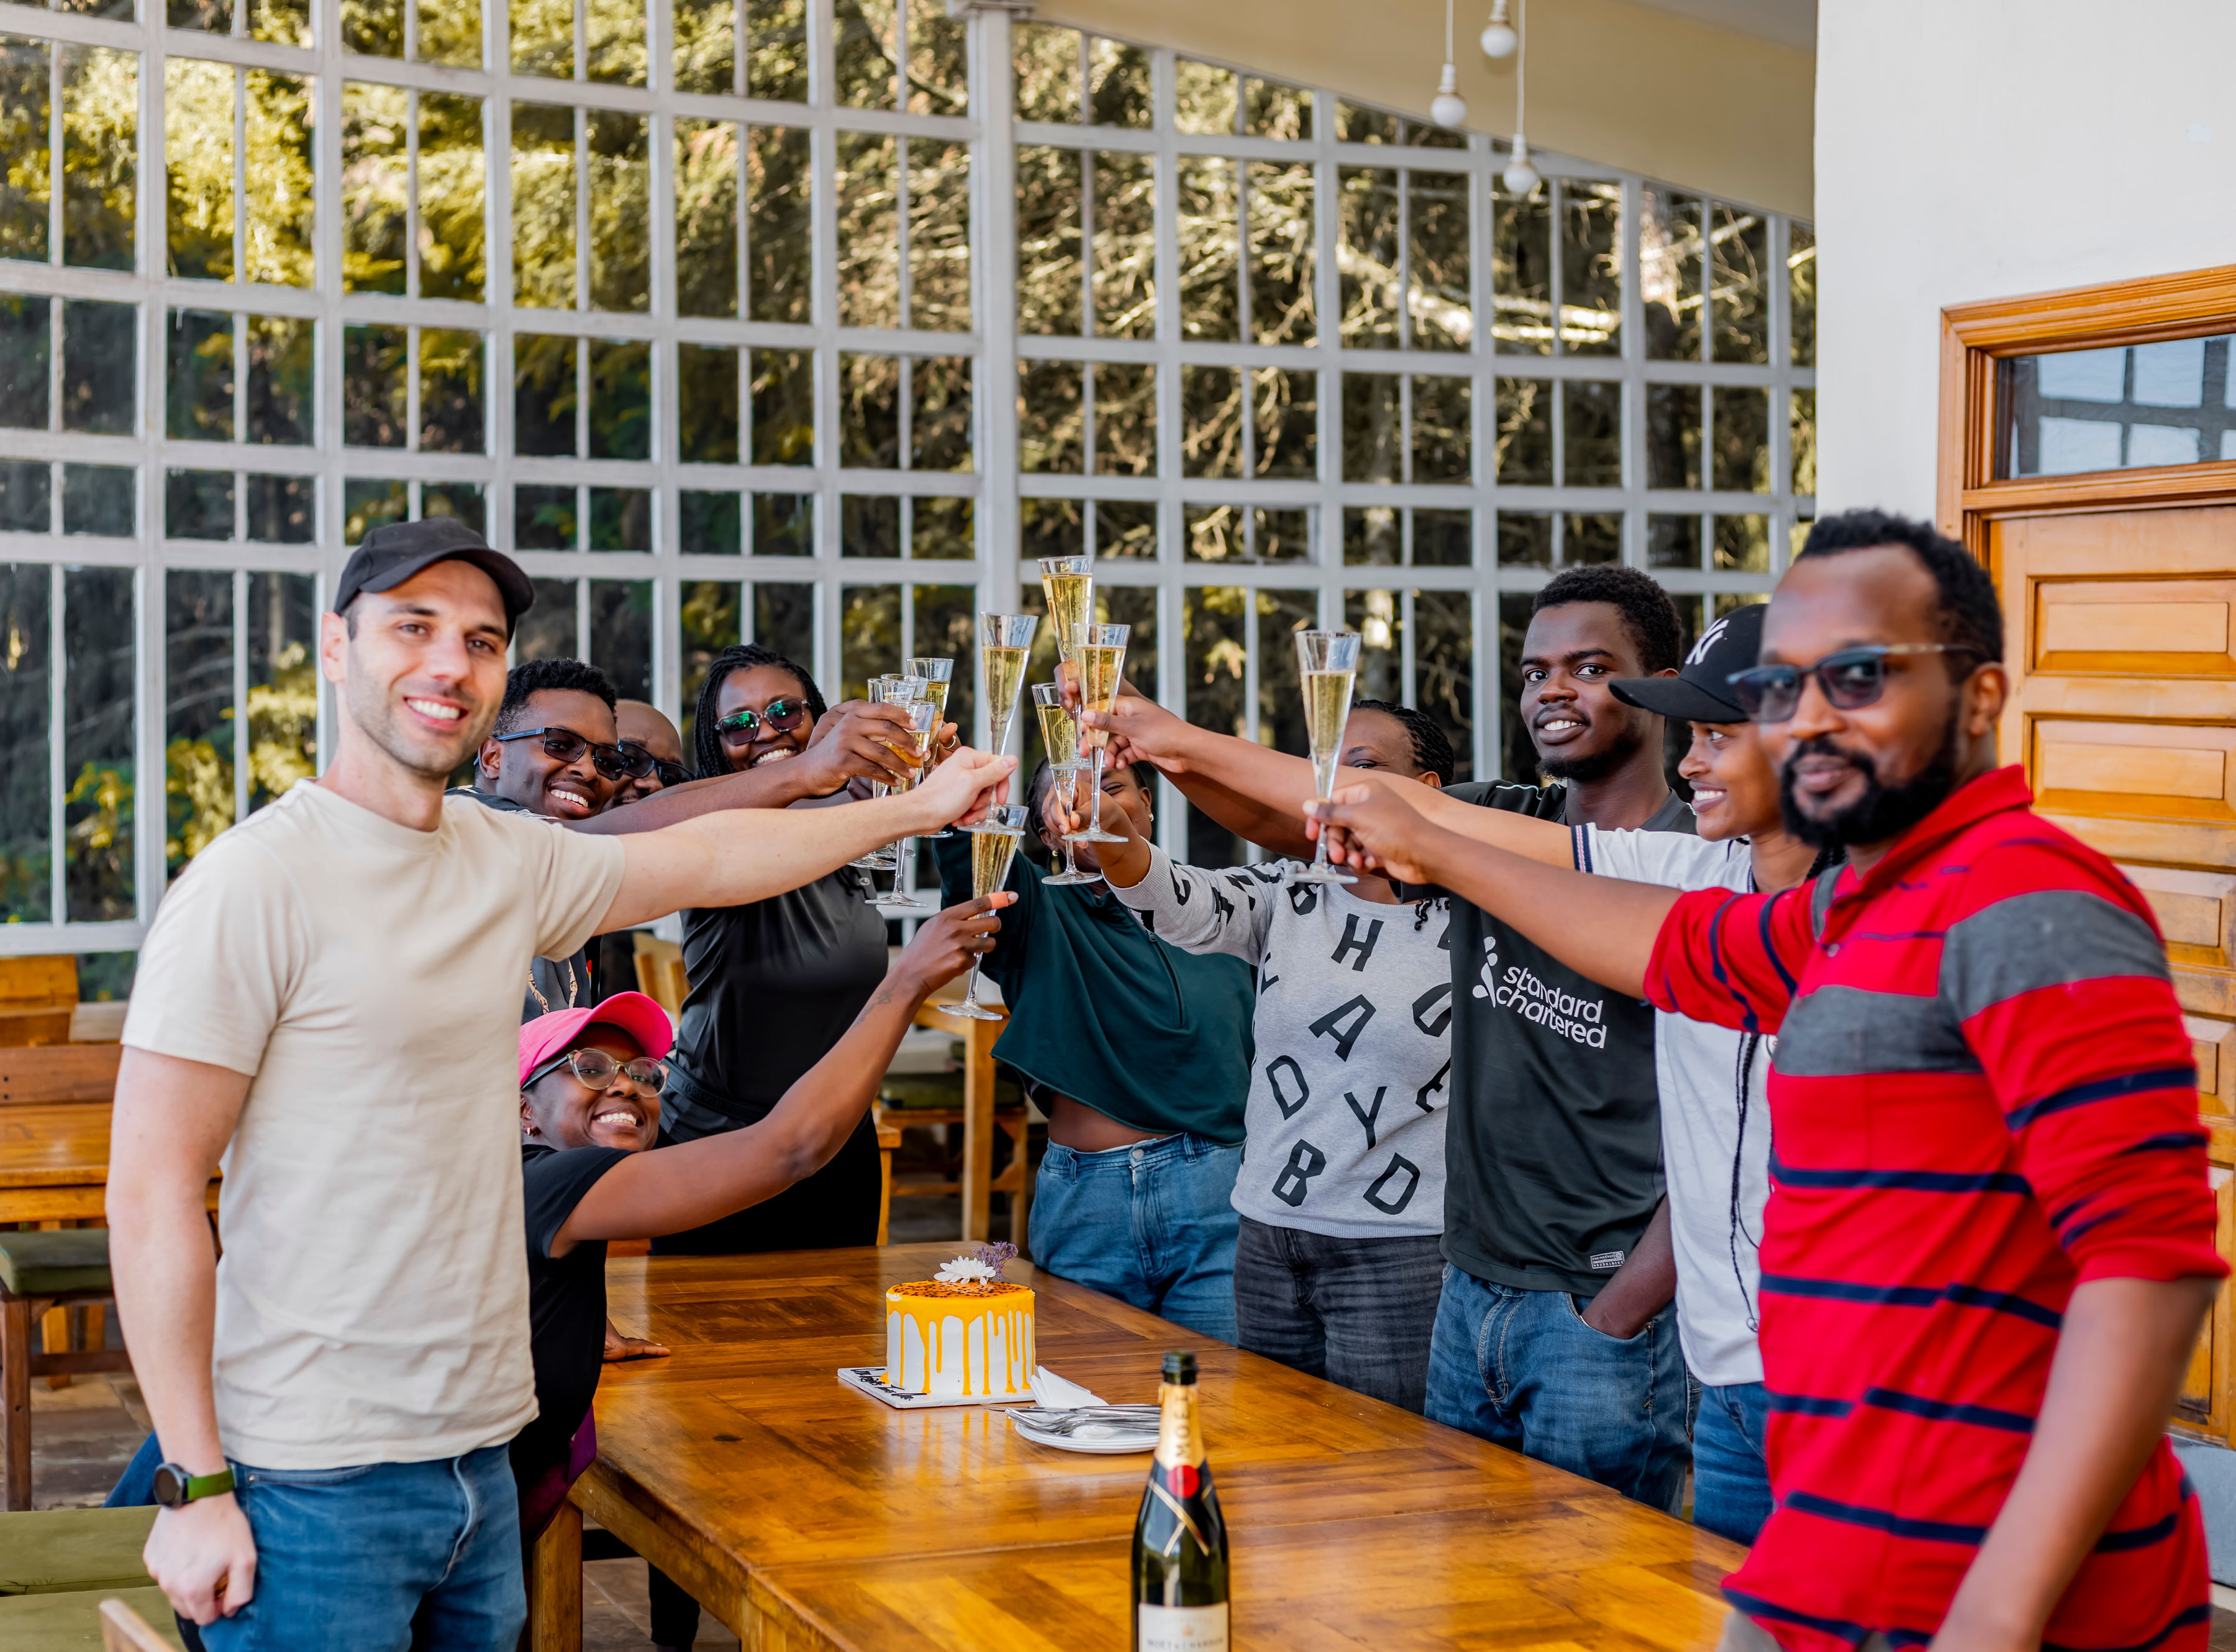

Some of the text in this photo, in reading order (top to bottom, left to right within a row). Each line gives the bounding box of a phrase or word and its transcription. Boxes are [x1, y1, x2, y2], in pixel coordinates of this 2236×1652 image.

[1685, 617, 1729, 665] NY
[1331, 913, 1384, 971] H
[1496, 986, 1607, 1049] chartered
[1502, 966, 1604, 1023] standard
[1308, 994, 1376, 1062] A
[1266, 1055, 1310, 1120] D
[1343, 1086, 1388, 1151] Y
[1272, 1138, 1327, 1207] B
[1363, 1152, 1420, 1215] D
